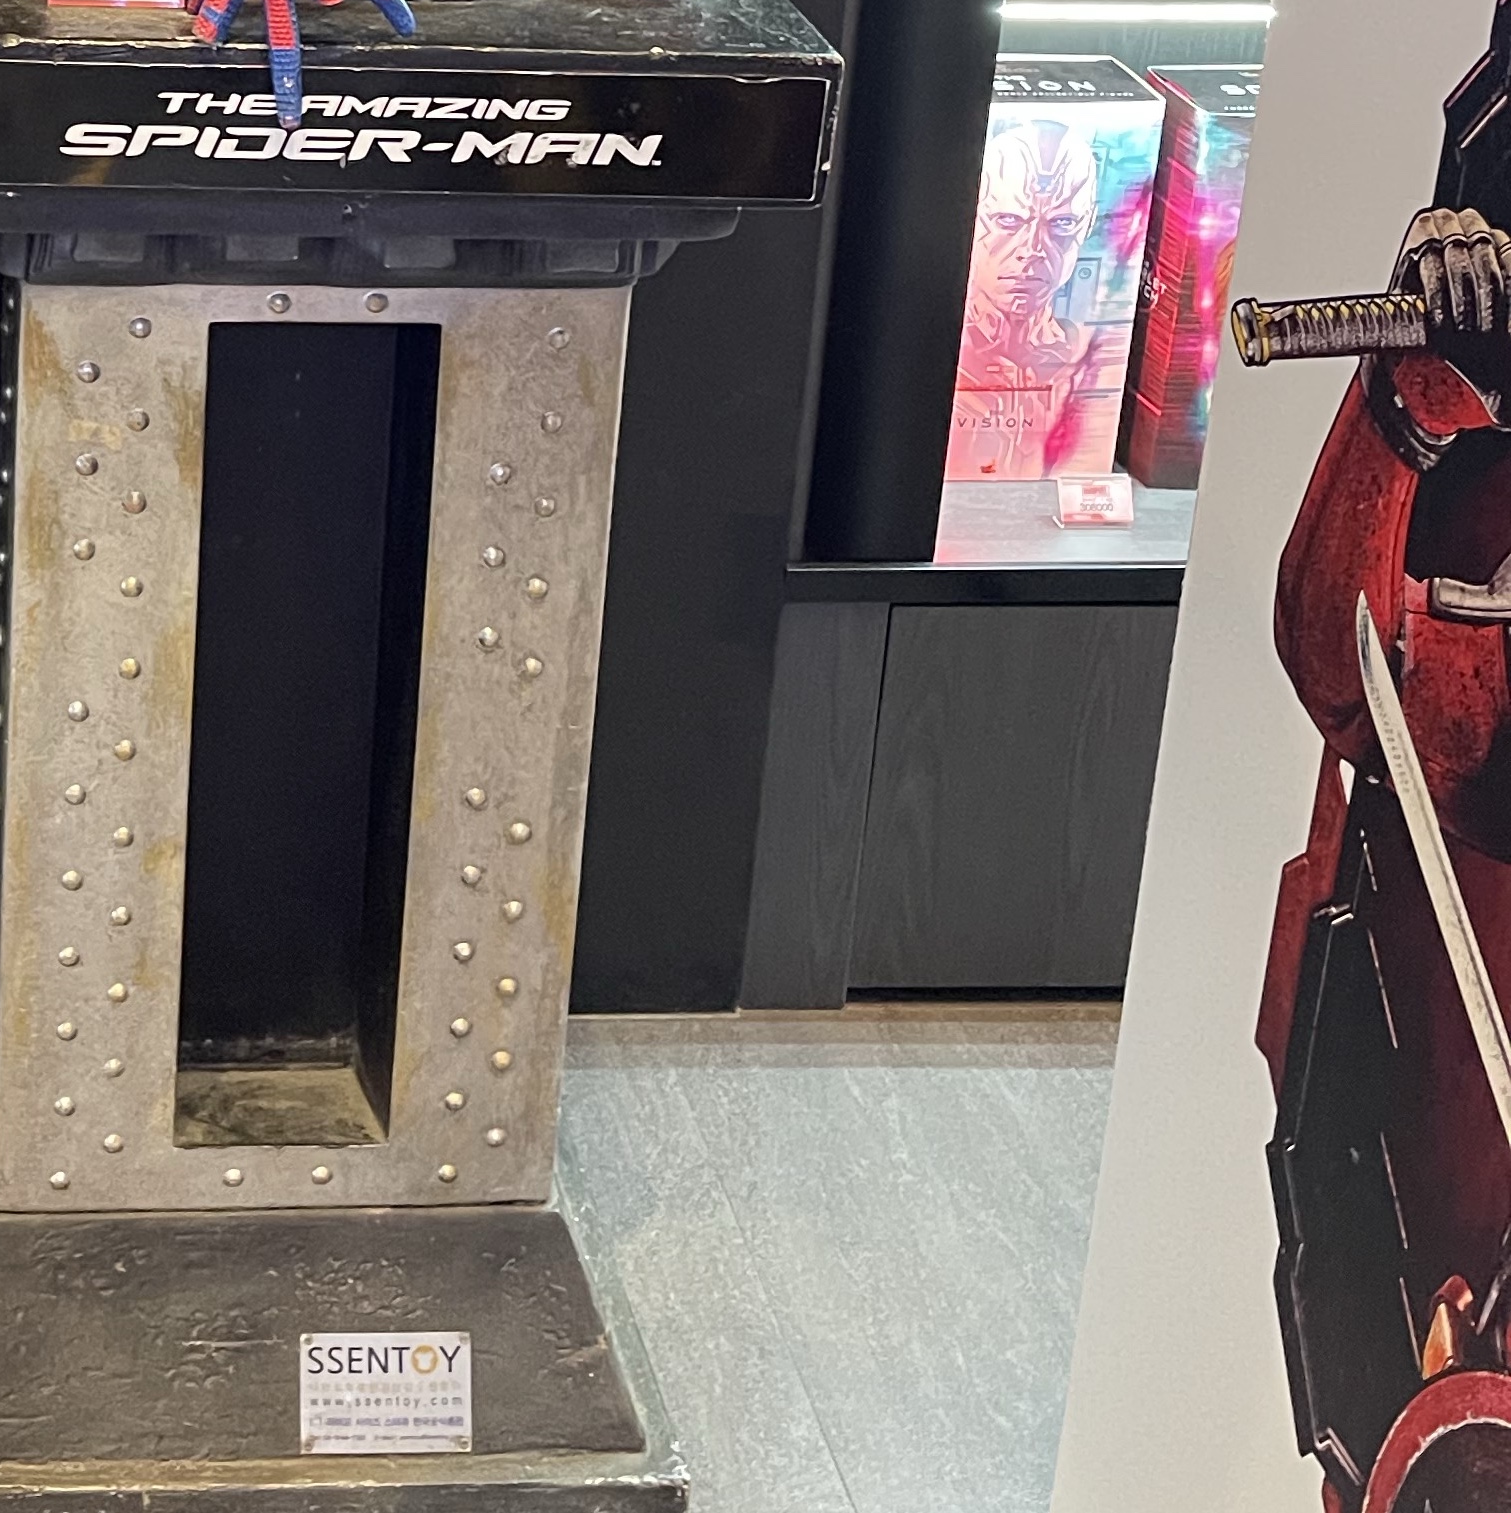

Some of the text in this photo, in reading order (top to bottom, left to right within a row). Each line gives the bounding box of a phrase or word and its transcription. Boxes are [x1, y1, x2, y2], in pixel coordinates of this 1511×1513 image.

[157, 91, 572, 122] THE AMAZING
[957, 417, 1034, 429] VISION
[307, 1345, 461, 1375] SSENTOY
[310, 1396, 463, 1409] www.ssentoy.com
